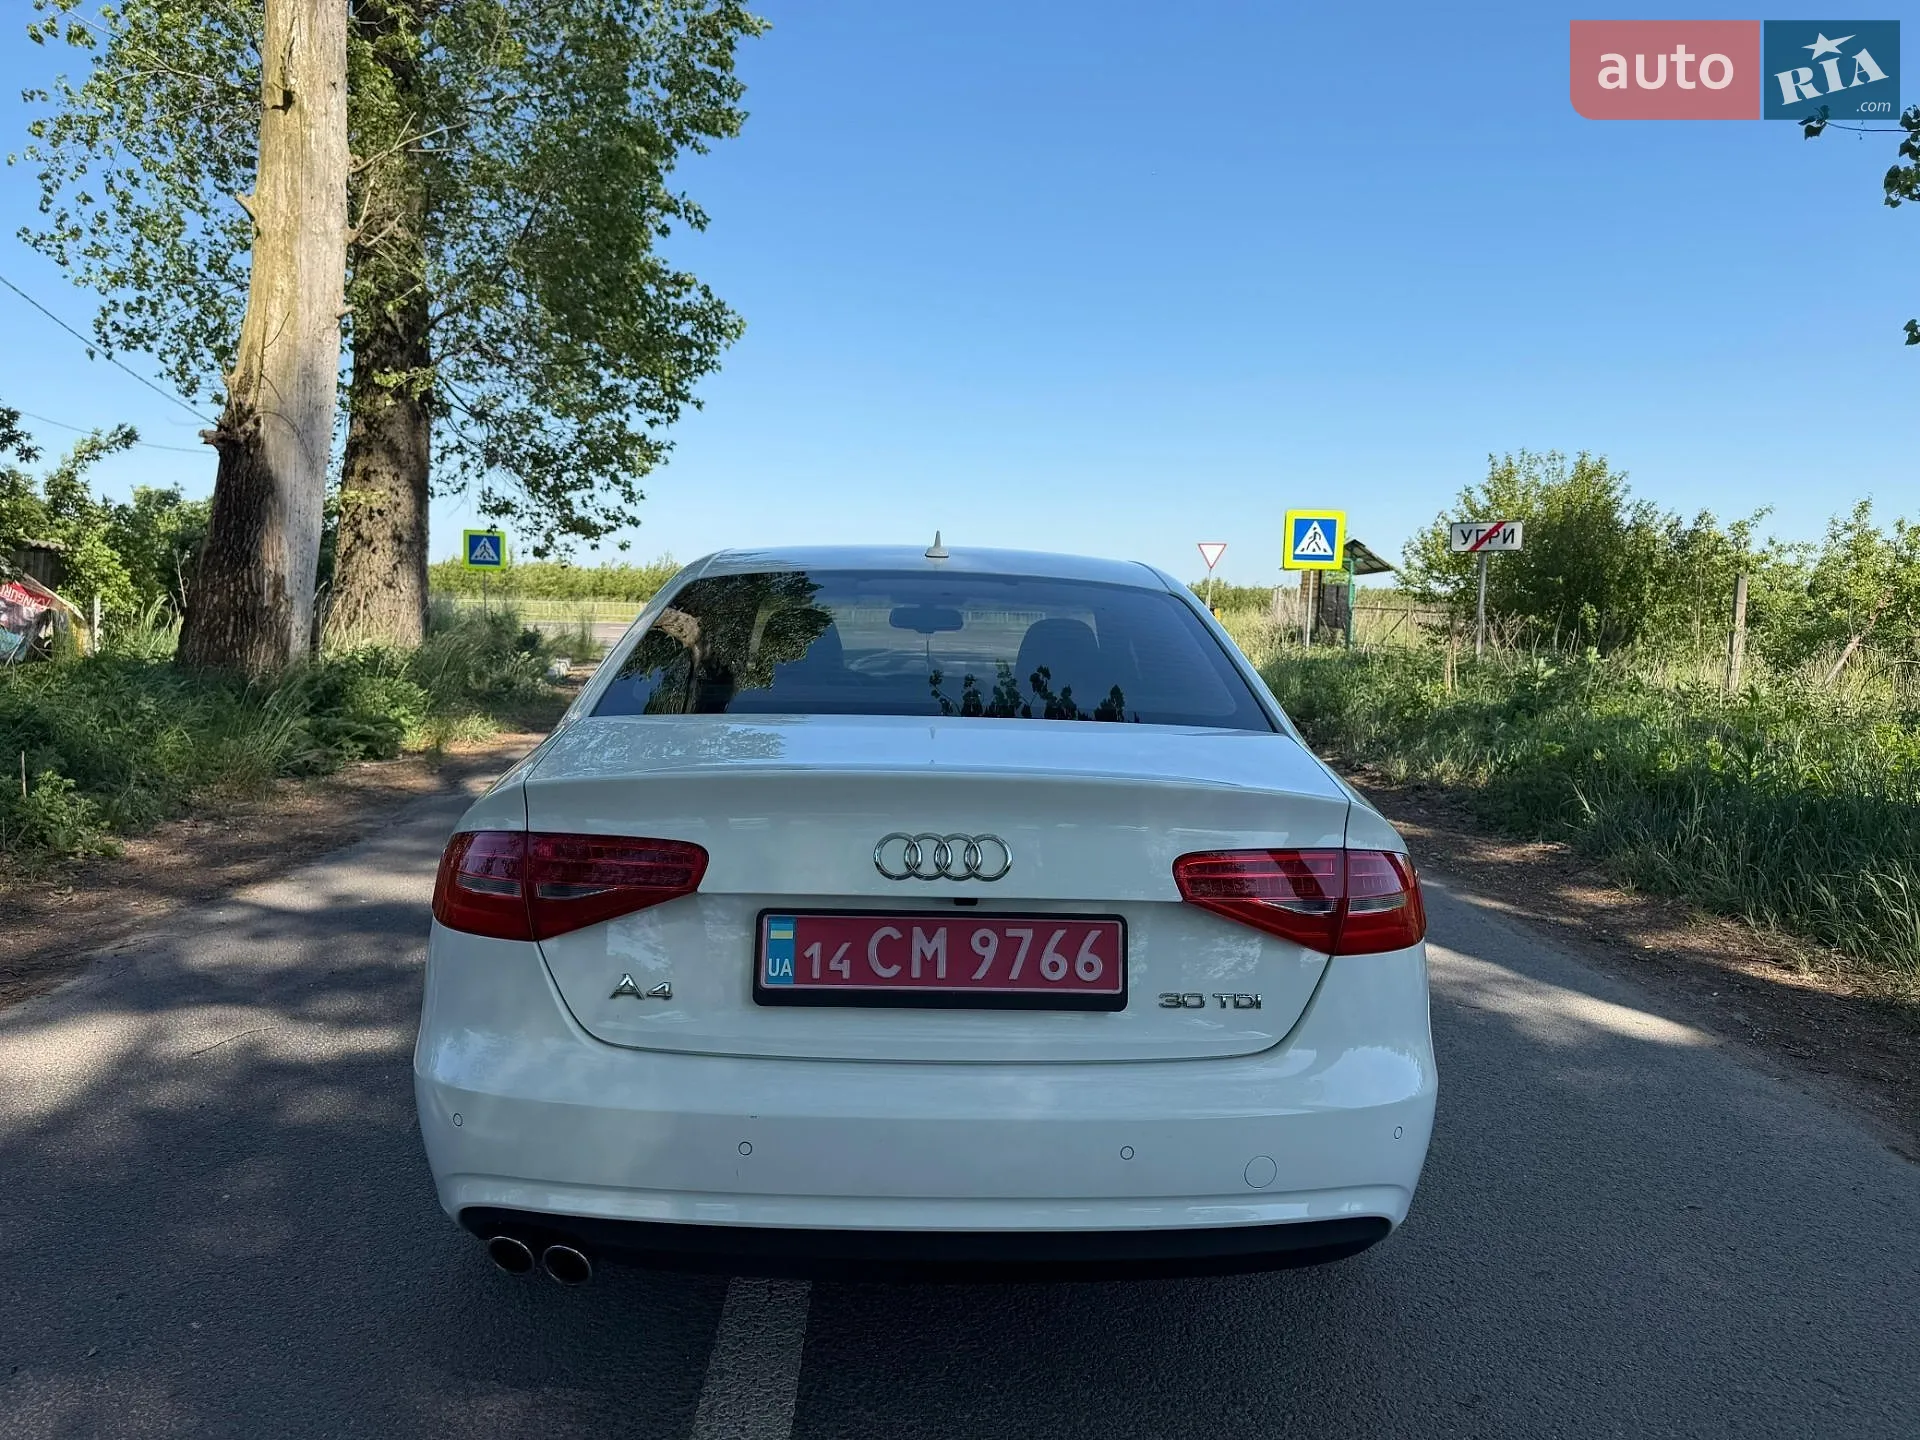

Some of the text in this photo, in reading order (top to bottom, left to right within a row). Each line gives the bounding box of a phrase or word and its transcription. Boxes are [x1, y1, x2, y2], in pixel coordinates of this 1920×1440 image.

[1460, 528, 1516, 545] УГРИ
[802, 925, 1104, 982] 14 CM 9766
[767, 957, 794, 977] UA
[608, 972, 674, 1001] A4
[1158, 992, 1263, 1010] 30 TDI
